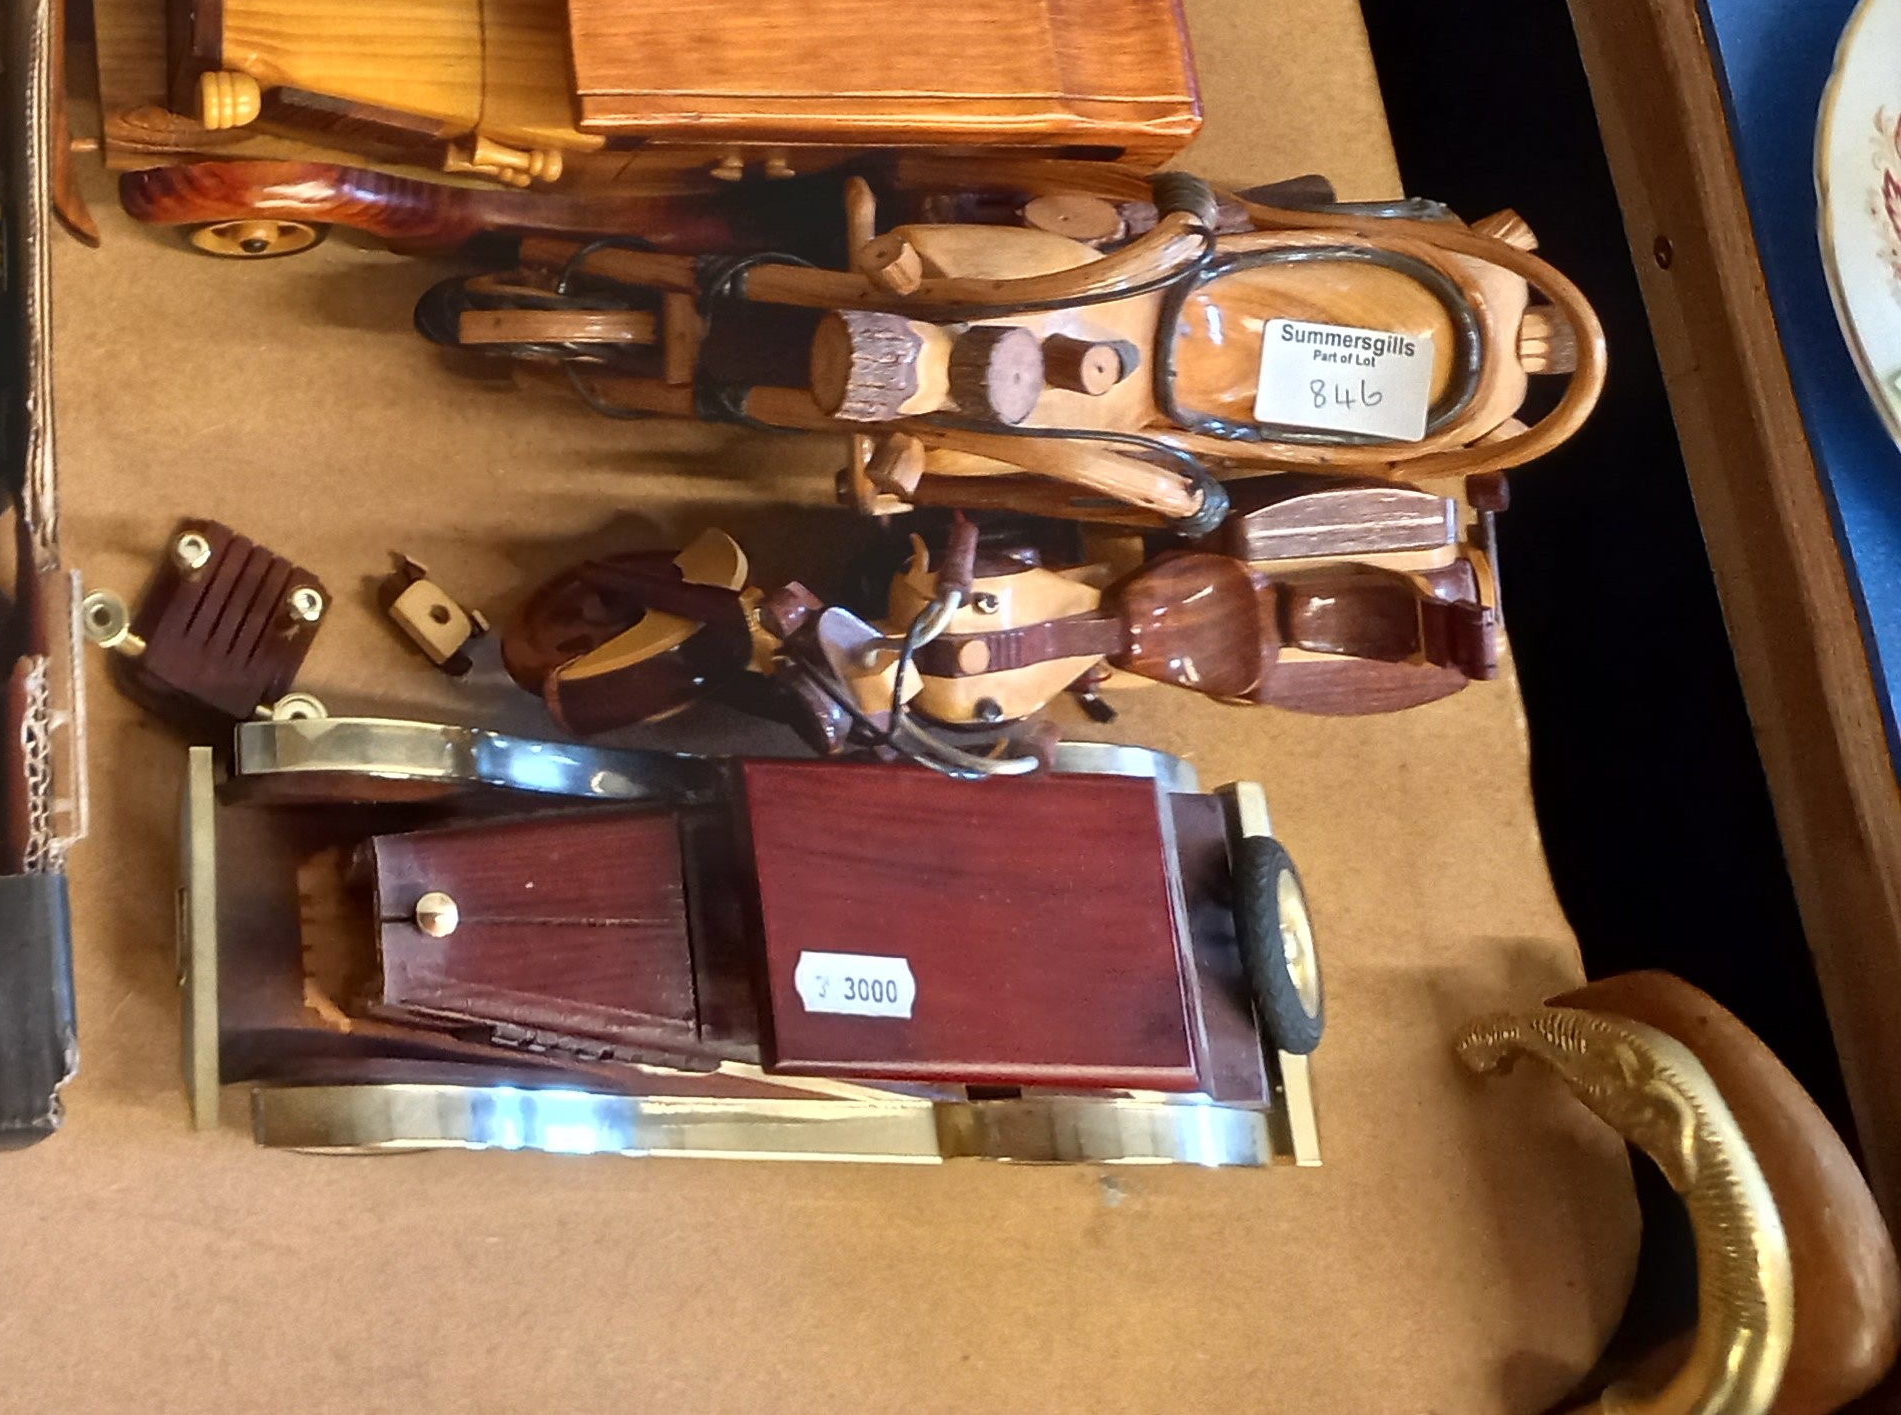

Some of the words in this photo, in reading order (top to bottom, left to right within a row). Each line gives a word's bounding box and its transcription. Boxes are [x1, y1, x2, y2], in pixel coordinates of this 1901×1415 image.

[1281, 323, 1416, 357] Summersgills
[1313, 349, 1338, 364] Part
[1340, 352, 1353, 364] of
[1355, 355, 1376, 368] Lot
[1309, 378, 1383, 410] 846
[843, 976, 898, 1004] 3000
